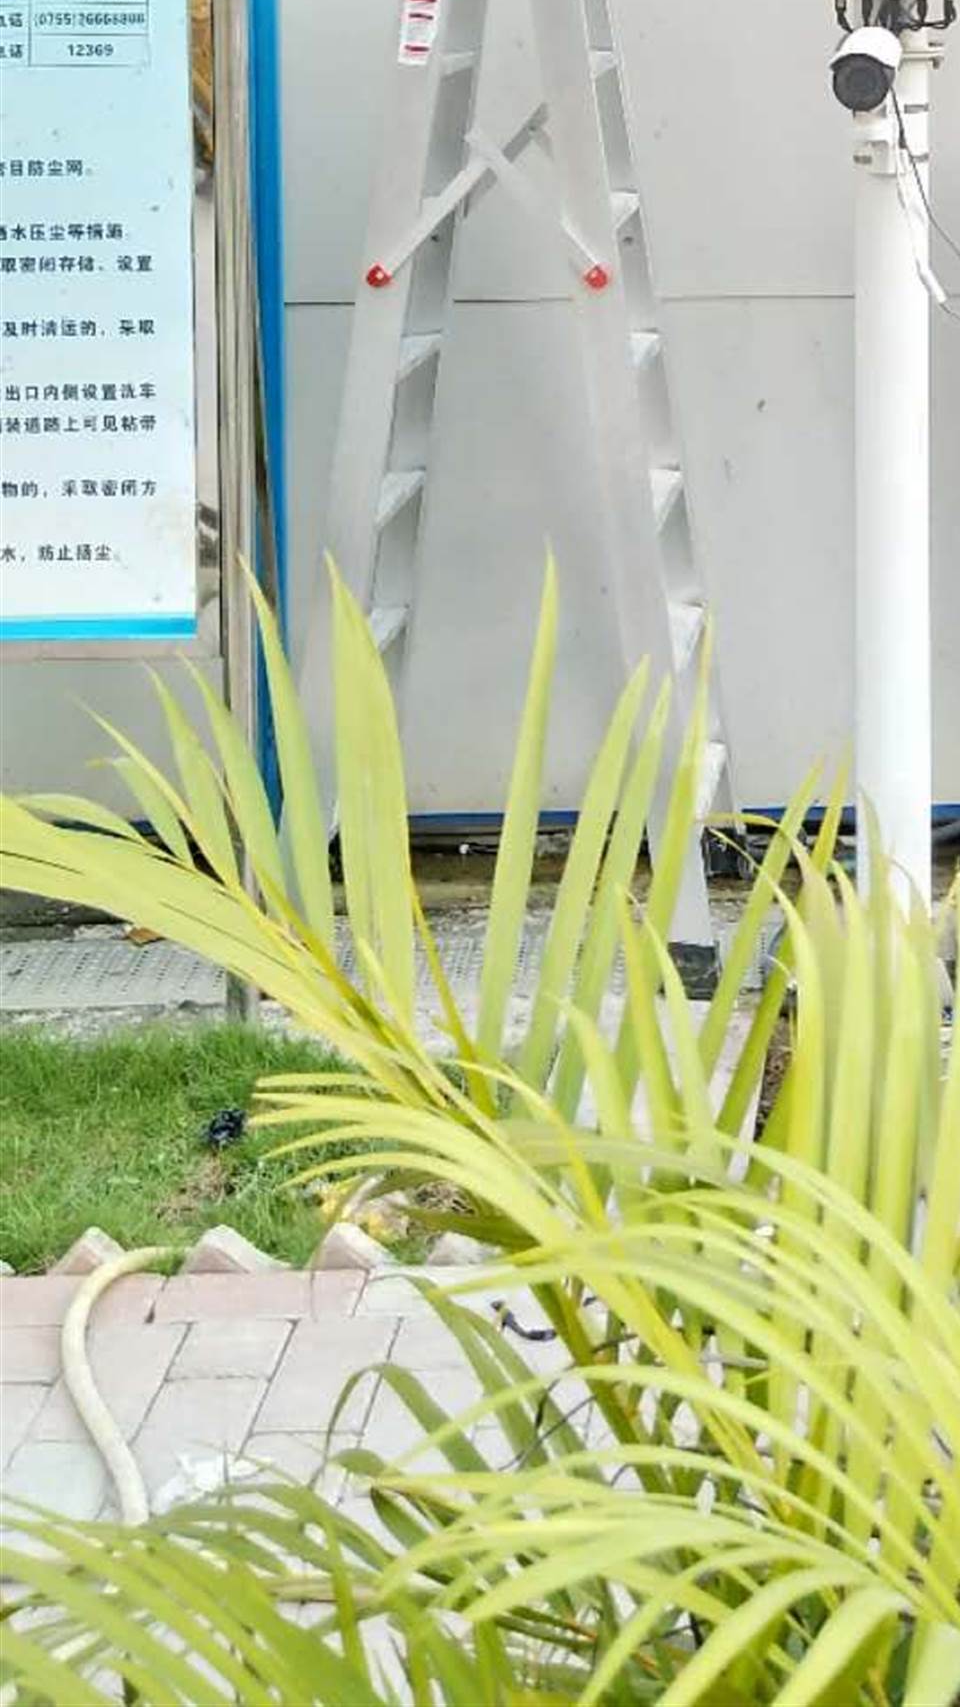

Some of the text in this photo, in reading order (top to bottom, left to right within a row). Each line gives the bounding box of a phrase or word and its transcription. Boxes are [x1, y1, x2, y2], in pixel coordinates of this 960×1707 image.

[67, 44, 114, 57] 12369
[0, 414, 156, 433] 装道路上可见粘带
